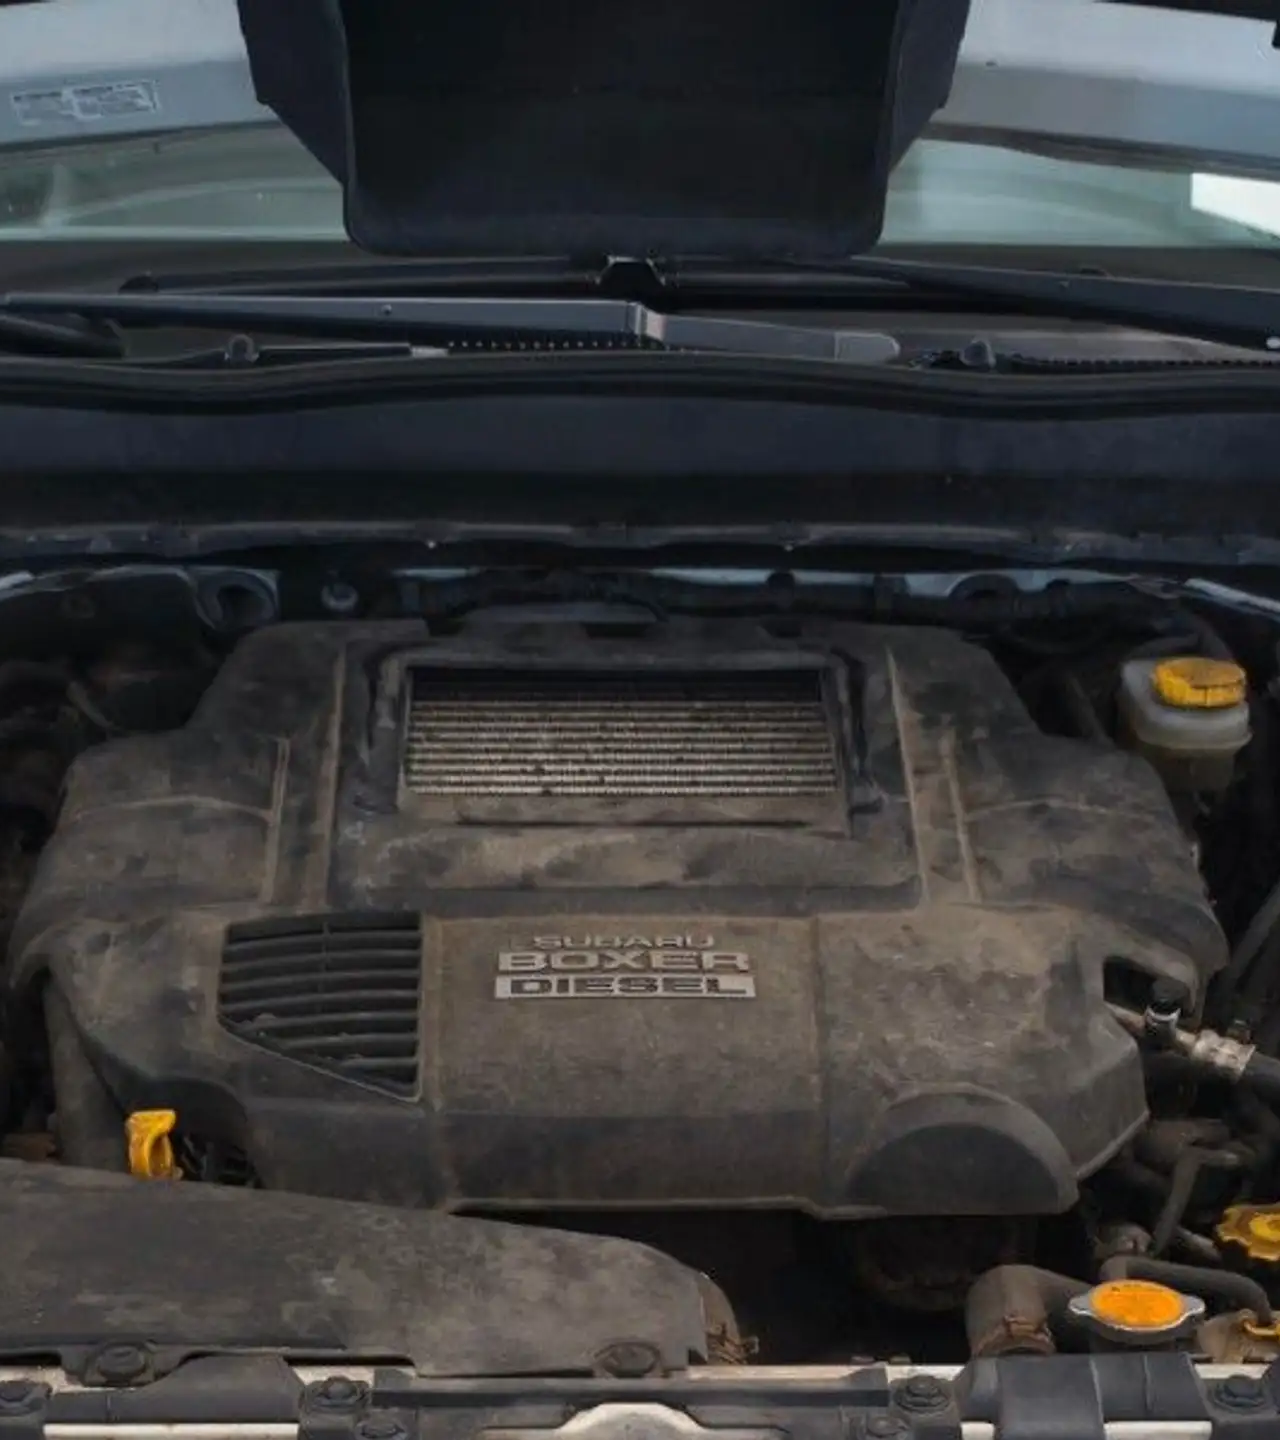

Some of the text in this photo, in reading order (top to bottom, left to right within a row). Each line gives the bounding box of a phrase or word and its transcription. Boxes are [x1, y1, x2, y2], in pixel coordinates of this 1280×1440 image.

[533, 935, 715, 949] SUBARU
[498, 950, 750, 972] BOXER
[505, 976, 751, 996] DIESEL
